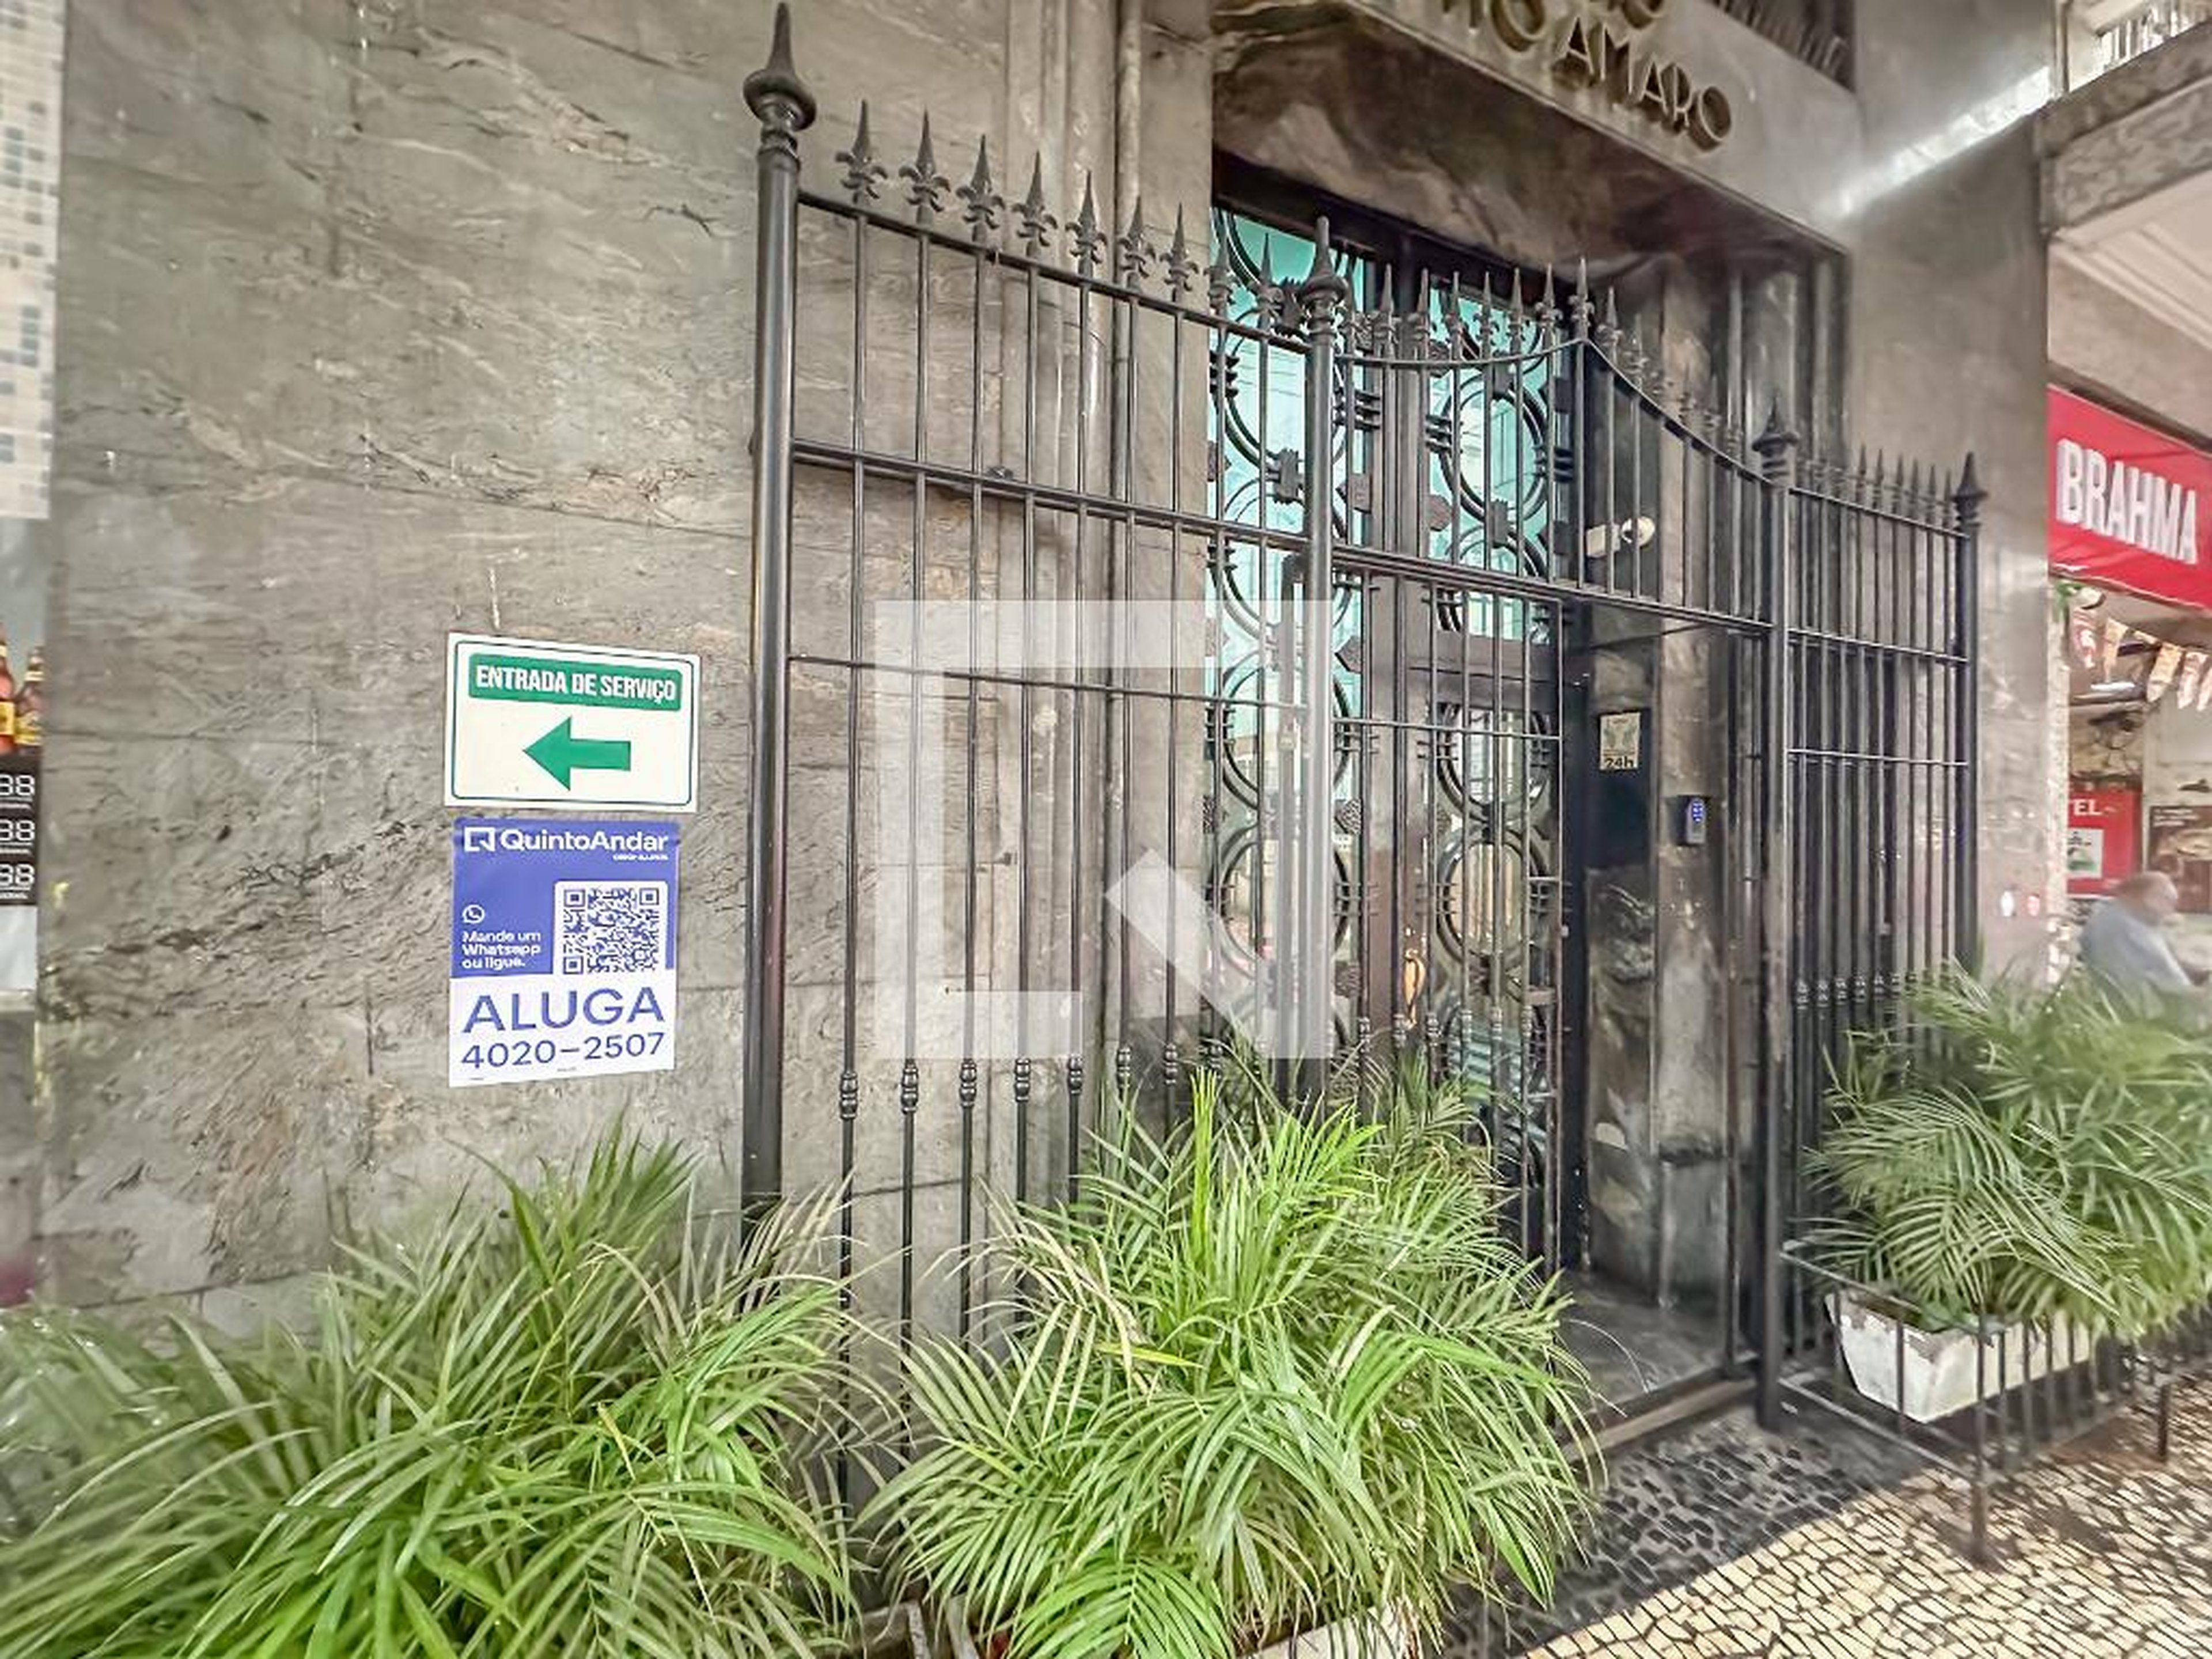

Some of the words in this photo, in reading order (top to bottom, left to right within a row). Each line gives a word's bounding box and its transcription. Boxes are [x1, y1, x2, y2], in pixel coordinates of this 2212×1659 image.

[1554, 16, 1731, 151] AMARO
[2056, 438, 2198, 564] BRAHMA
[476, 664, 569, 695] ENTRADA
[571, 673, 597, 696] DE
[600, 675, 676, 704] SERVIÇO
[1604, 756, 1634, 768] 24h
[501, 828, 668, 851] QuintoAndar
[462, 929, 514, 942] Mande
[517, 931, 541, 942] um
[462, 958, 483, 969] ou
[463, 987, 665, 1033] ALUGA
[461, 1032, 665, 1069] 4020-2507
